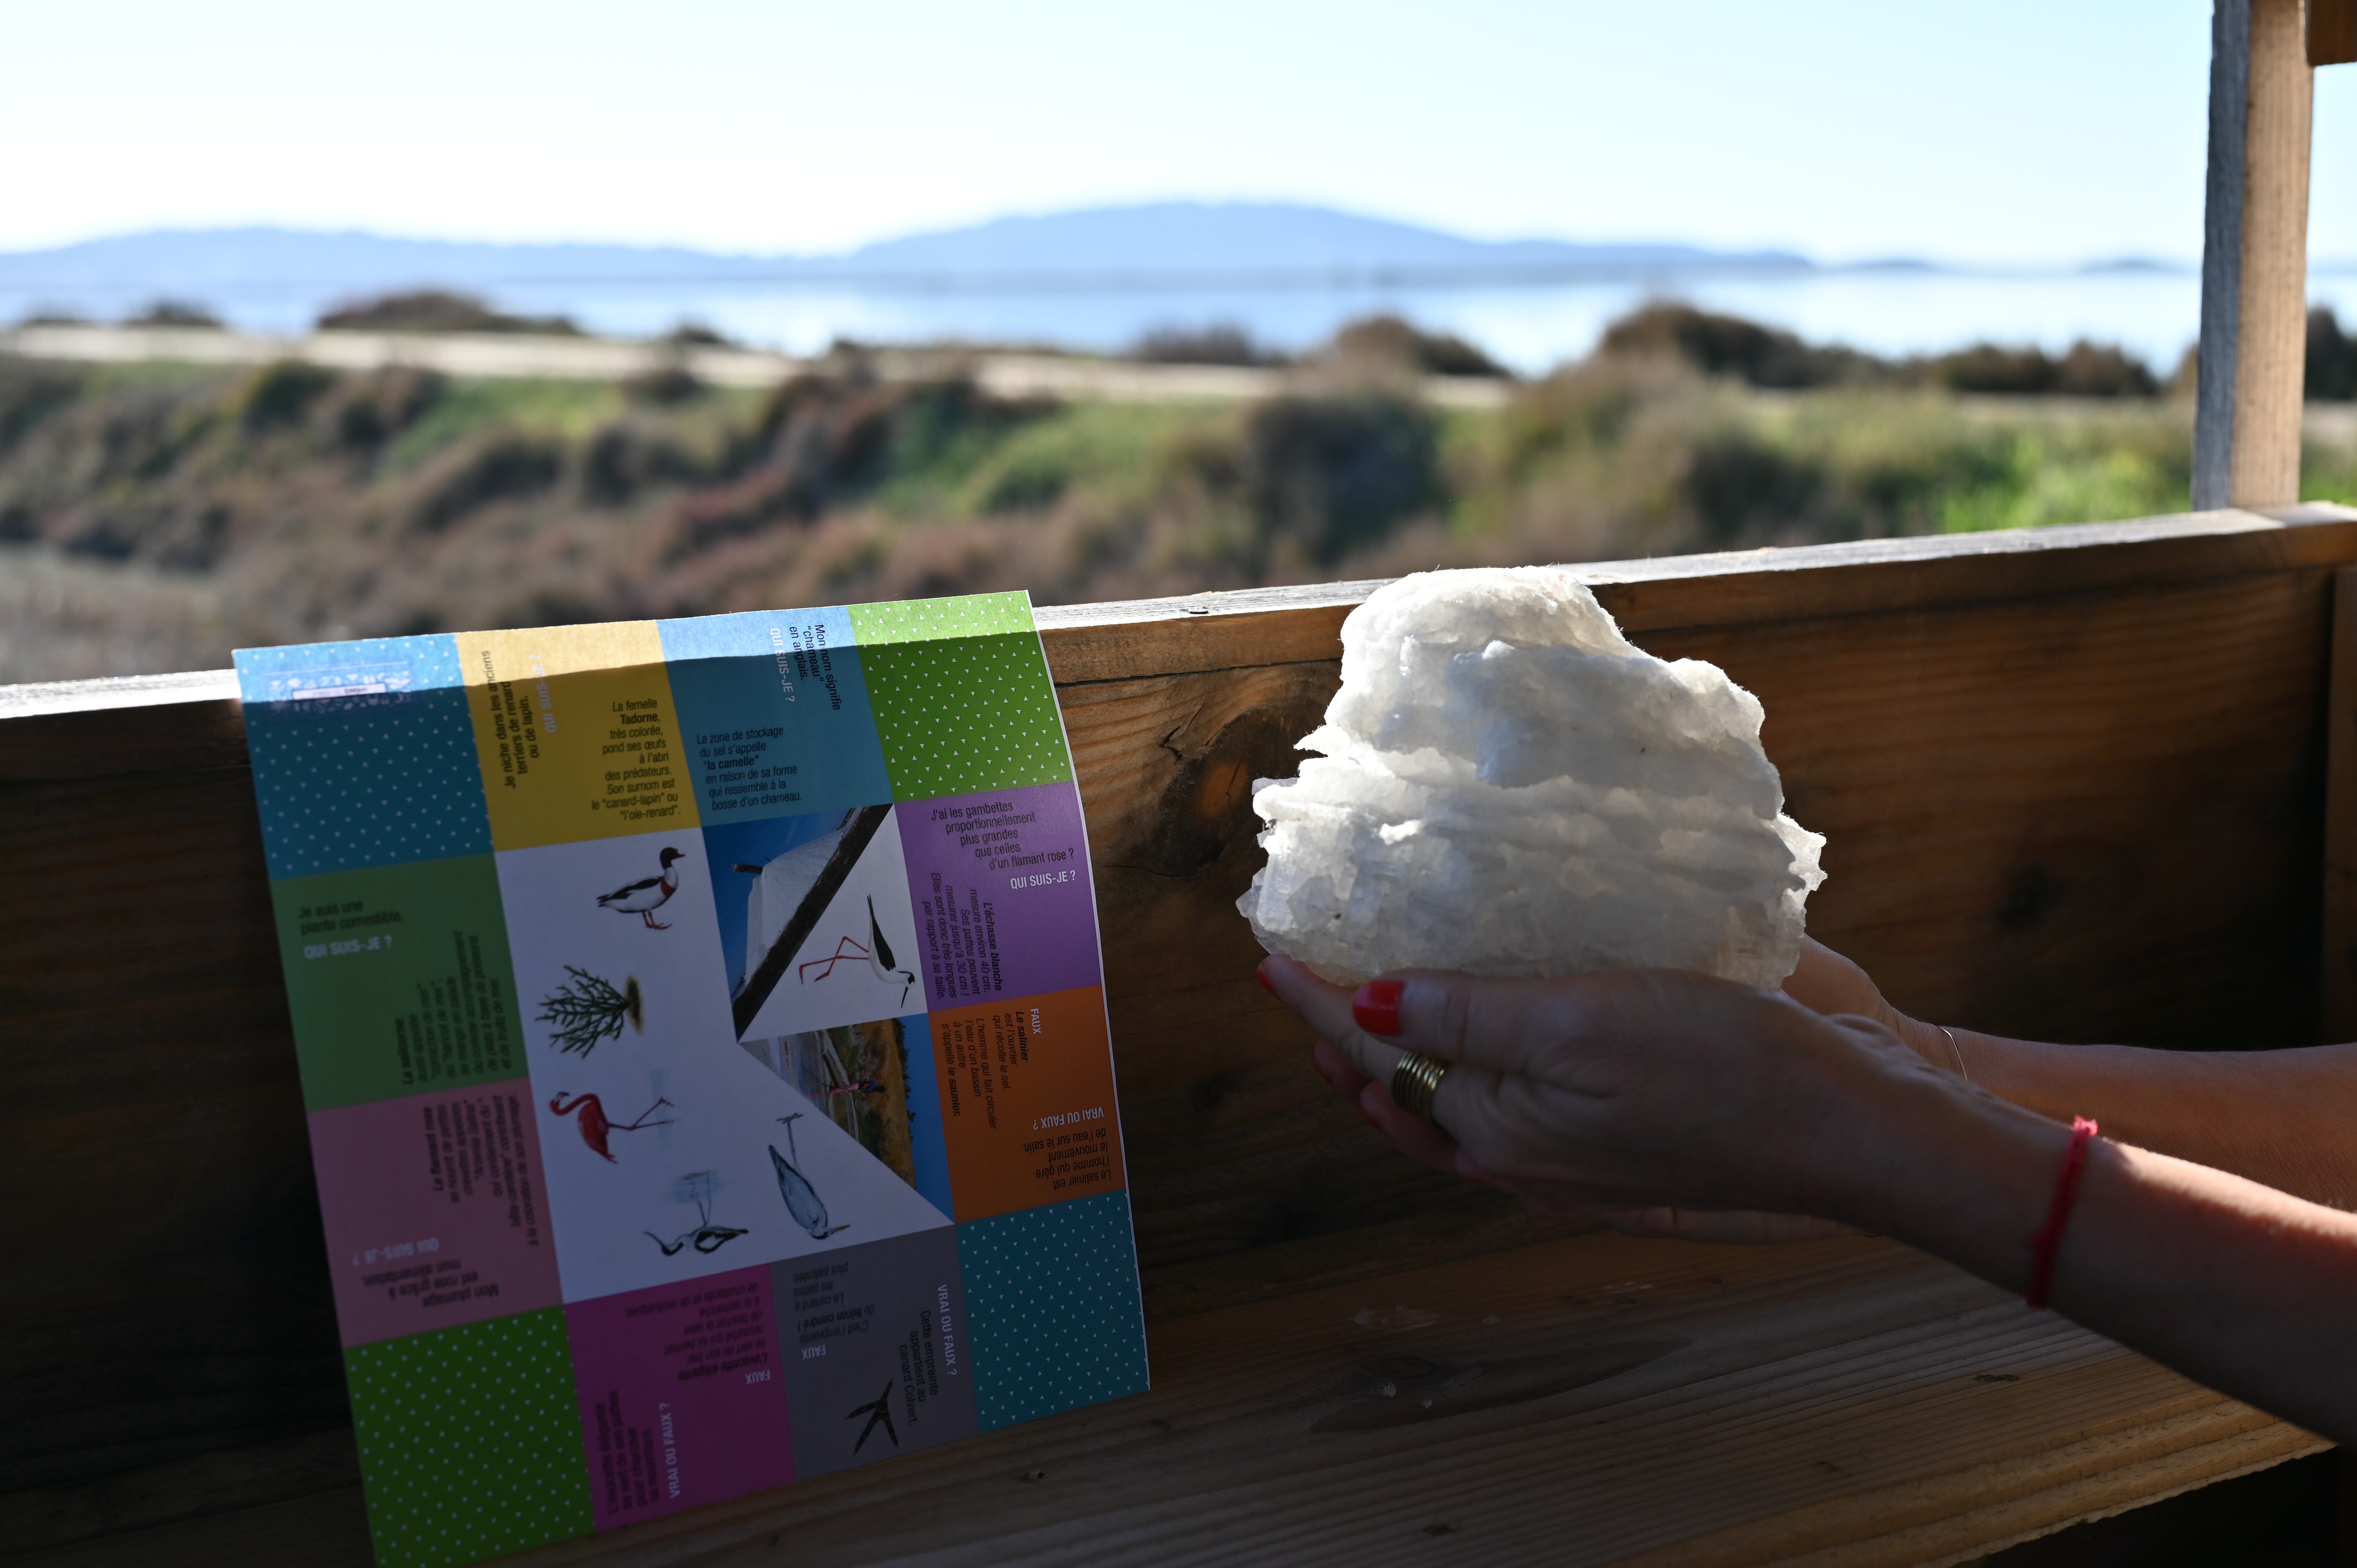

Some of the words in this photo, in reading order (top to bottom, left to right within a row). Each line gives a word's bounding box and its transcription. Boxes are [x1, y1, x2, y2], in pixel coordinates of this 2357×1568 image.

[770, 627, 783, 646] QUI
[789, 626, 799, 638] en
[814, 624, 825, 646] Mon
[793, 642, 809, 680] anglais.
[820, 649, 831, 671] nom
[775, 649, 793, 692] SUIS-JE
[825, 674, 841, 710] signifie
[612, 702, 623, 712] La
[625, 698, 657, 710] femelle
[620, 713, 660, 724] Tadorne,
[696, 734, 707, 745] La
[710, 733, 730, 743] zone
[732, 730, 743, 740] de
[746, 727, 783, 739] stockage
[700, 747, 710, 758] du
[713, 745, 725, 756] sel
[705, 775, 717, 784] en
[719, 771, 745, 782] raison
[747, 768, 758, 779] de
[760, 769, 770, 778] sa
[772, 766, 797, 776] forme
[709, 786, 722, 799] qui
[724, 781, 768, 795] ressemble
[770, 779, 776, 790] à
[778, 779, 786, 789] la
[712, 799, 737, 810] bosse
[761, 792, 802, 805] chameau.
[949, 807, 963, 818] les
[965, 802, 1013, 818] gambettes
[945, 811, 1036, 835] proportionnellement
[960, 833, 979, 848] plus
[982, 828, 1018, 844] grandes
[975, 847, 991, 859] que
[994, 842, 1021, 855] celles
[1011, 852, 1045, 866] flamant
[1047, 851, 1066, 862] rose
[1068, 848, 1074, 858] ?
[931, 872, 942, 893] Elles
[1010, 876, 1027, 889] QUI
[1029, 871, 1068, 886] SUIS-JE
[1070, 870, 1075, 880] ?
[921, 901, 933, 917] par
[934, 895, 946, 916] sont
[945, 885, 958, 923] mesurer
[969, 889, 981, 923] mesure
[960, 909, 970, 925] Ses
[925, 919, 939, 952] rapport
[938, 918, 948, 940] donc
[961, 928, 974, 956] pattes
[975, 925, 986, 958] environ
[942, 943, 952, 960] très
[933, 962, 941, 973] sa
[956, 961, 967, 973] 30
[966, 958, 981, 994] peuvent
[981, 961, 990, 973] 40
[990, 952, 1002, 991] blanche
[935, 976, 946, 999] taille.
[945, 962, 957, 998] longues
[959, 975, 967, 990] cm
[982, 975, 990, 992] cm.
[992, 1015, 1003, 1029] qui
[1004, 1013, 1014, 1027] est
[1016, 1011, 1024, 1023] Le
[1030, 1008, 1041, 1034] FAUX
[954, 1030, 963, 1042] un
[1017, 1026, 1029, 1062] salinier
[995, 1031, 1006, 1062] récolte
[956, 1044, 966, 1068] autre
[947, 1067, 956, 1075] le
[981, 1062, 991, 1076] qui
[970, 1068, 982, 1097] bassin
[984, 1079, 993, 1093] fait
[1001, 1075, 1011, 1091] sel.
[949, 1078, 961, 1116] saunier.
[985, 1095, 997, 1129] circuler
[1067, 1111, 1080, 1123] OU
[1082, 1107, 1104, 1121] VRAI
[1033, 1119, 1038, 1130] ?
[1040, 1114, 1064, 1129] FAUX
[1057, 1135, 1070, 1146] sur
[1095, 1128, 1106, 1139] de
[1021, 1140, 1044, 1153] salin.
[1046, 1138, 1054, 1149] le
[1100, 1141, 1108, 1152] le
[1047, 1143, 1097, 1163] mouvement
[1035, 1164, 1055, 1178] gère
[1057, 1161, 1070, 1176] qui
[1101, 1169, 1111, 1180] Le
[1052, 1178, 1065, 1191] est
[1068, 1171, 1099, 1187] salinier
[938, 1284, 950, 1312] VRAI
[836, 1307, 862, 1321] héron
[864, 1304, 875, 1315] du
[797, 1321, 800, 1332] !
[803, 1313, 834, 1331] cendré
[920, 1310, 932, 1338] Cette
[941, 1315, 952, 1332] OU
[801, 1344, 826, 1360] FAUX
[909, 1330, 926, 1386] appartient
[943, 1335, 956, 1366] FAUX
[899, 1344, 913, 1382] canard
[924, 1341, 939, 1396] empreinte
[745, 1369, 770, 1384] FAUX
[917, 1388, 926, 1402] au
[659, 1402, 669, 1411] ?
[904, 1384, 918, 1426] Colvert.
[661, 1412, 674, 1445] FAUX
[665, 1447, 677, 1465] OU
[667, 1467, 680, 1498] VRAI
